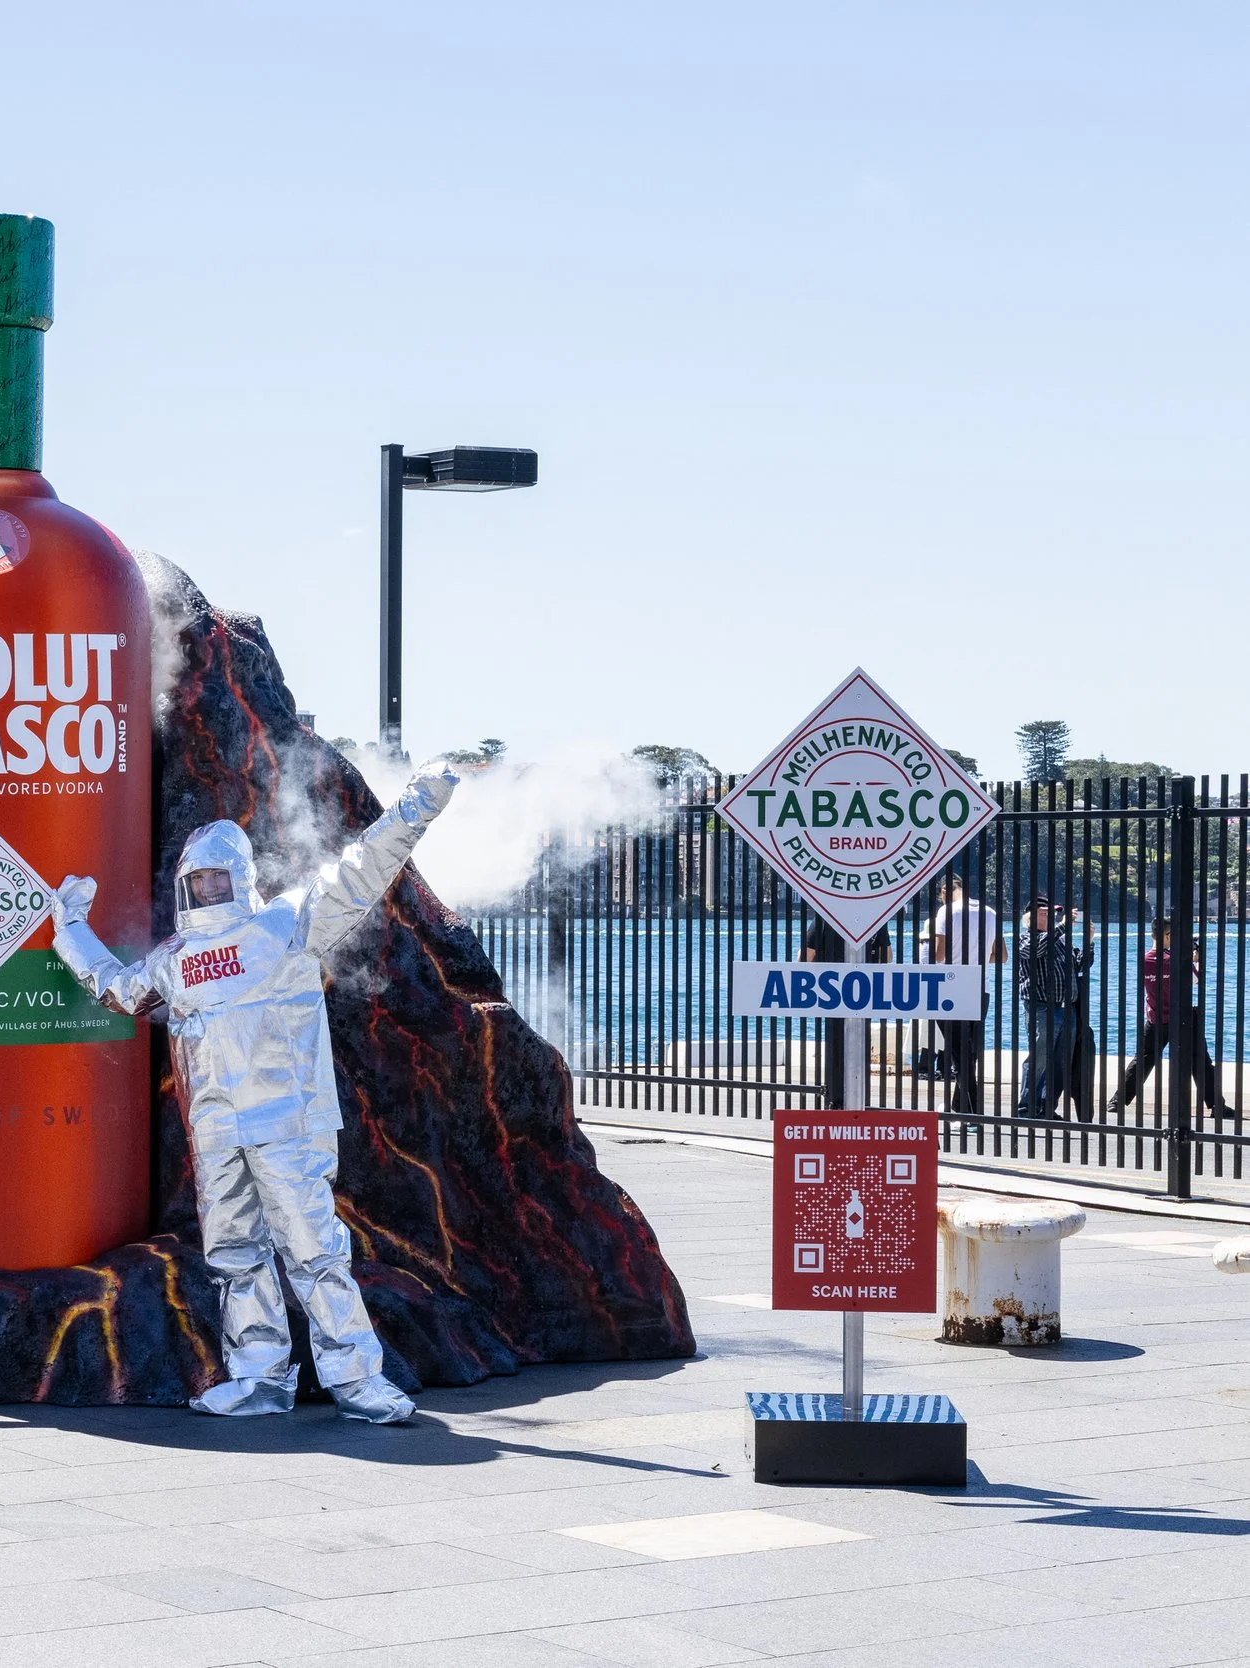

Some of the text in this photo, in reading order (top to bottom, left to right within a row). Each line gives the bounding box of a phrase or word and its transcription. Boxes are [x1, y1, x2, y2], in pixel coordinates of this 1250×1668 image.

[118, 719, 127, 773] BRAND
[55, 781, 104, 795] VODKA
[746, 788, 971, 829] TABASCO
[829, 836, 888, 850] BRAND
[783, 835, 932, 892] PEPPER BLEND
[46, 961, 65, 971] FIN
[181, 944, 238, 976] ABSOLUT
[41, 1021, 53, 1030] OF
[81, 1018, 110, 1028] SWEDEN
[783, 1125, 928, 1141] GET IT WHILE ITS HOT.
[811, 1285, 897, 1299] SCAN HERE
